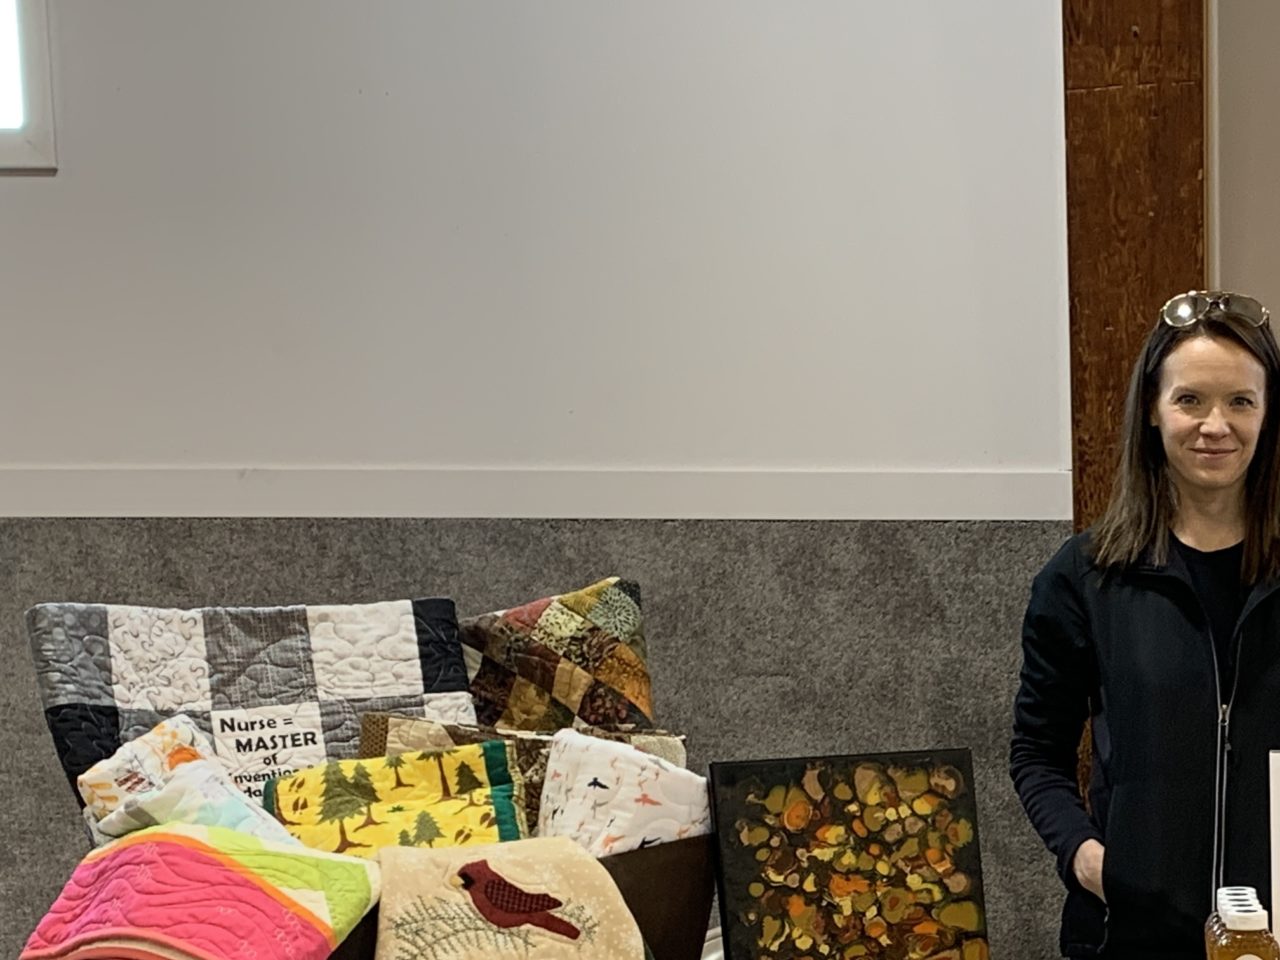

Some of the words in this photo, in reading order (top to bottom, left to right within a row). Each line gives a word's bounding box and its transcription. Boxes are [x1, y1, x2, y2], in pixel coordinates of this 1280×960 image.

[219, 717, 277, 733] Nurse
[235, 731, 317, 753] MASTER
[263, 753, 278, 766] of
[228, 767, 300, 784] nventio
